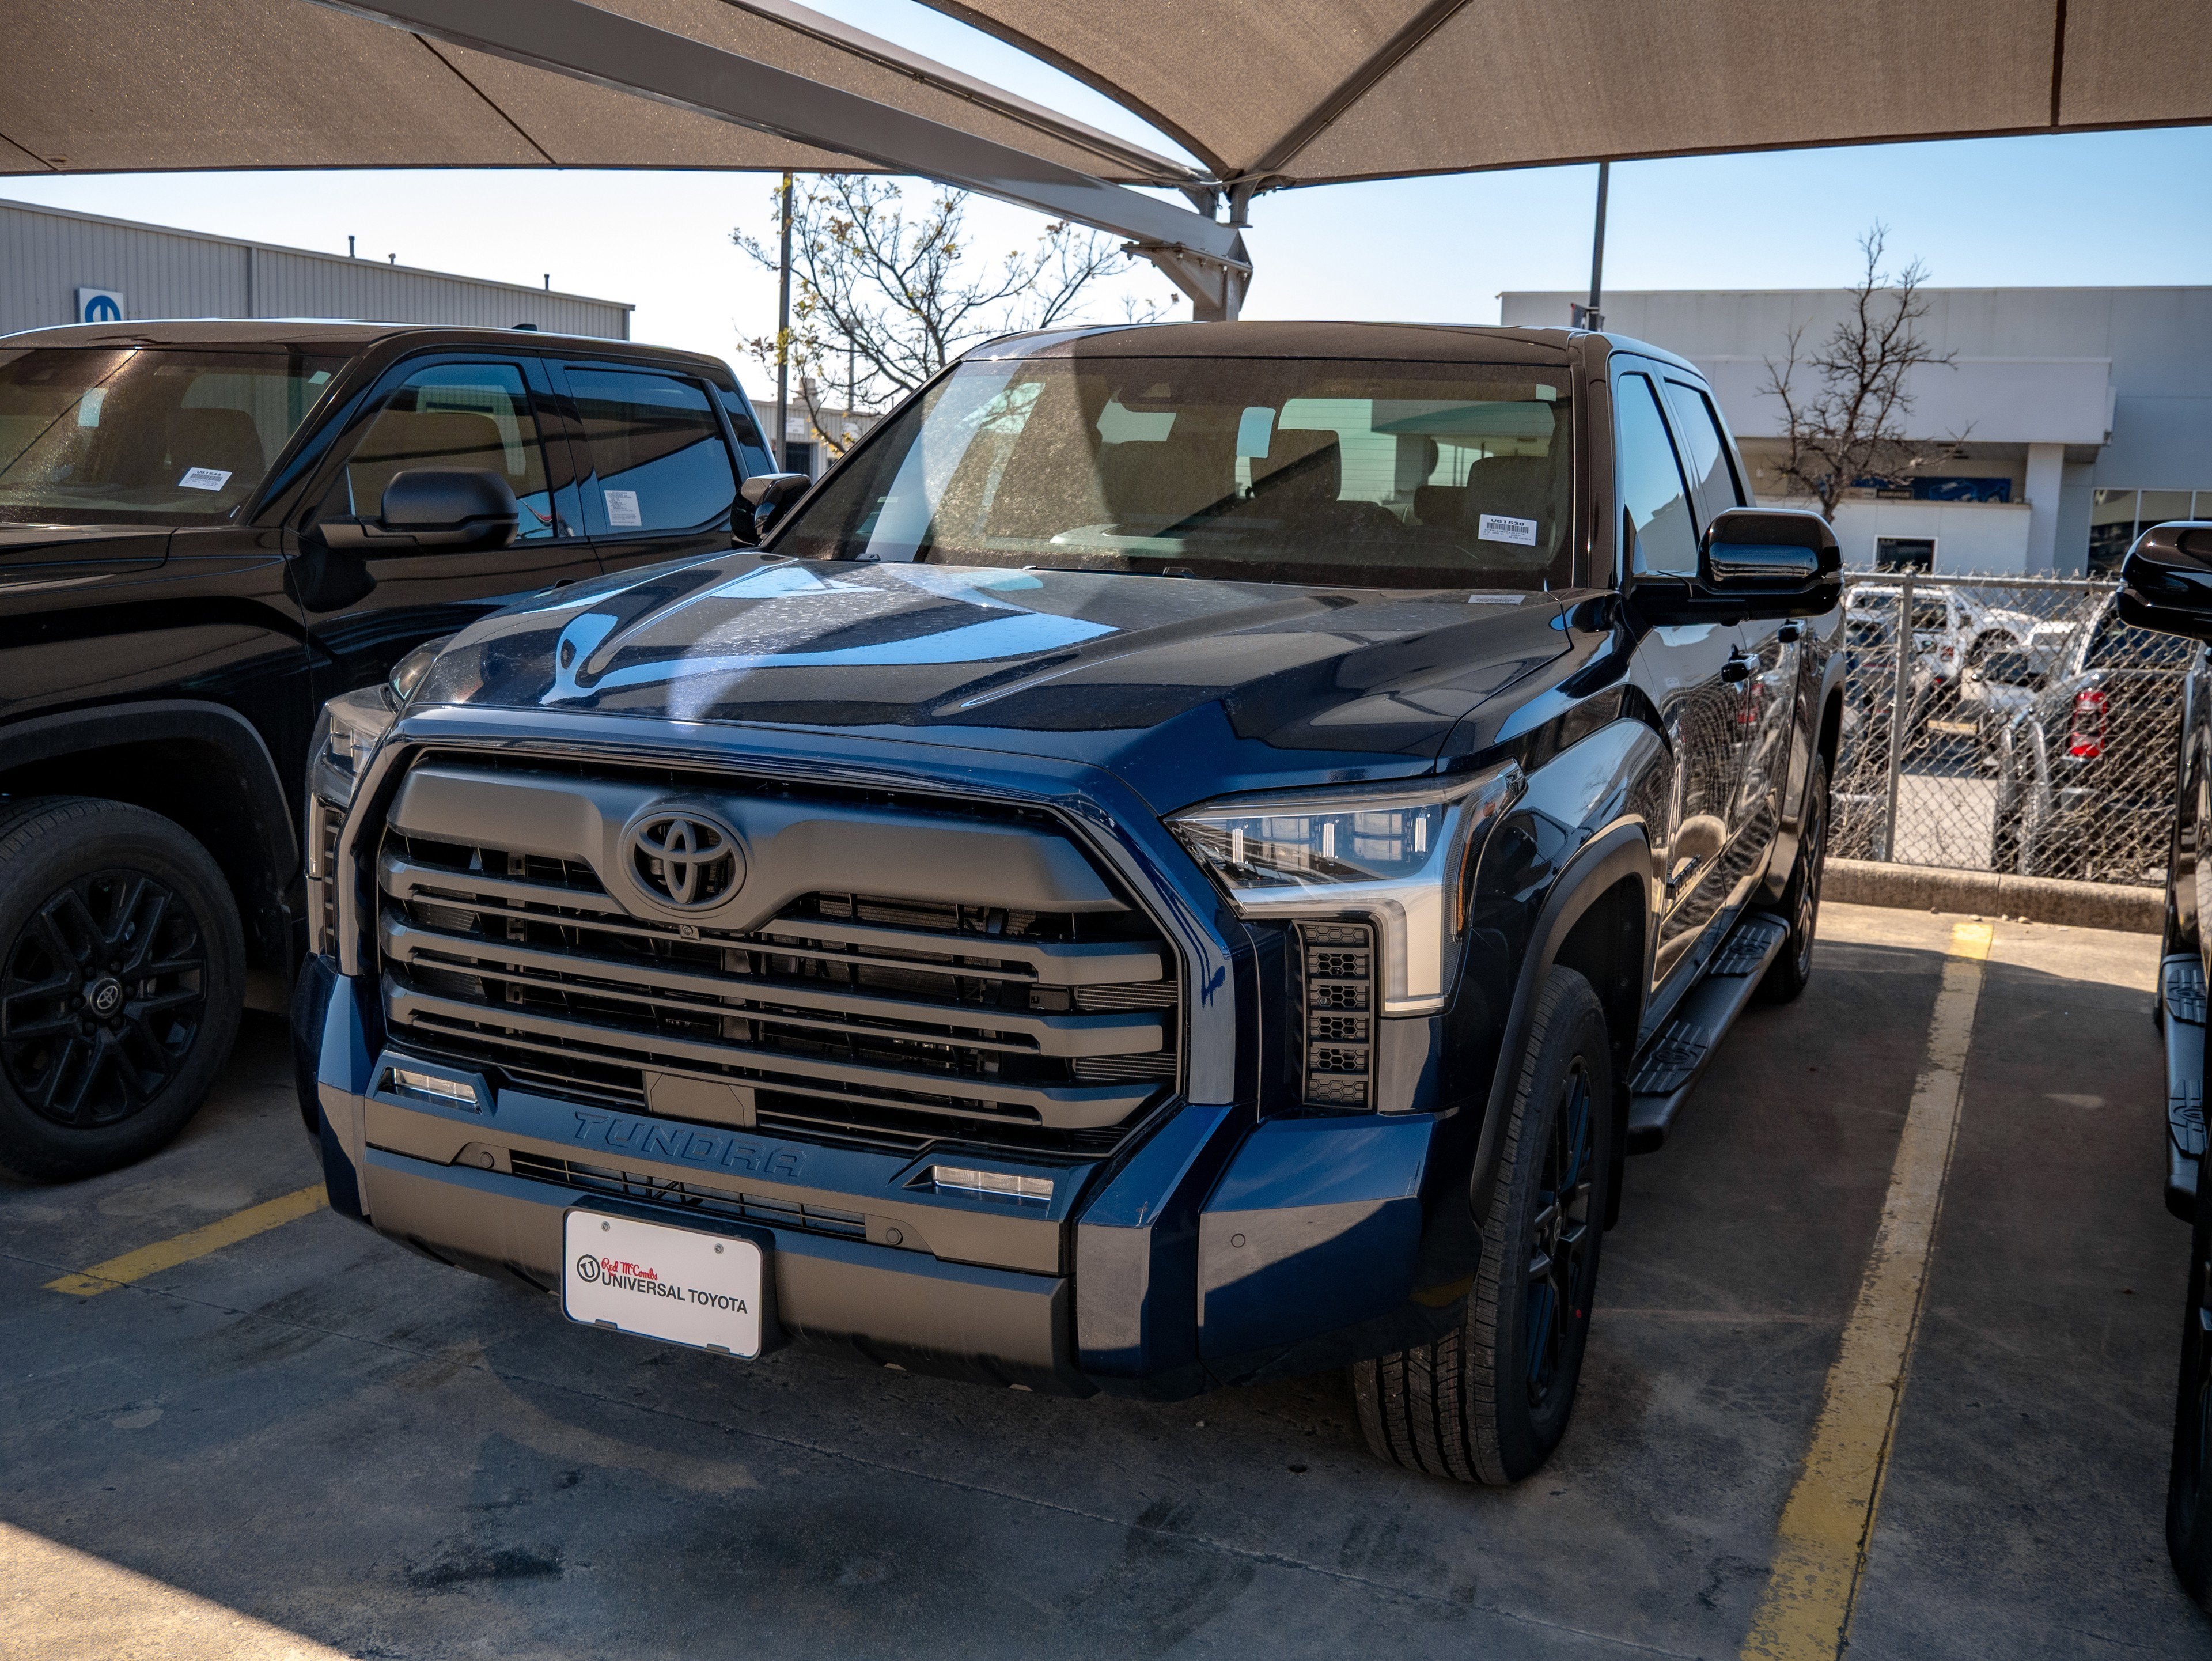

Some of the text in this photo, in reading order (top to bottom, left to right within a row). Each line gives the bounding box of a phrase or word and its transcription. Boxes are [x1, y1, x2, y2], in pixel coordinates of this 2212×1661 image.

[574, 1111, 807, 1177] TUNDRA
[601, 1257, 658, 1281] Red McCombs
[601, 1272, 748, 1314] UNIVERSAL TOYOTA
